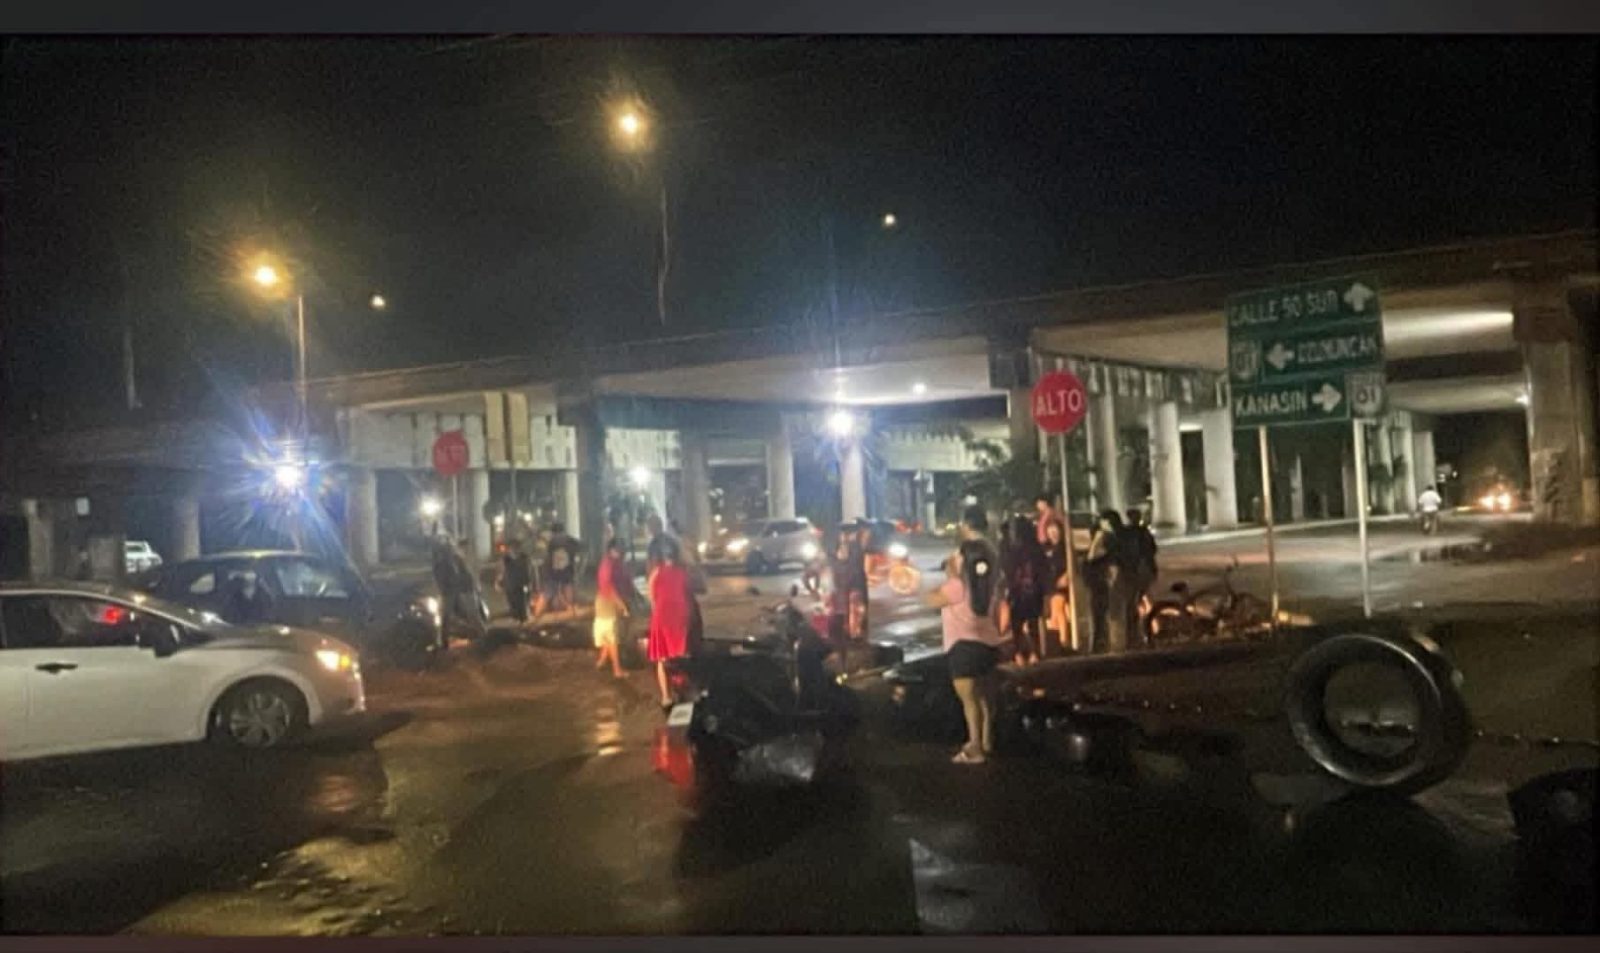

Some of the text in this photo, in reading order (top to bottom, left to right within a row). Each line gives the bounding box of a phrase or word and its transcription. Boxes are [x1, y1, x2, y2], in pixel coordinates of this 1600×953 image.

[1231, 300, 1279, 326] CALLE
[1036, 389, 1083, 416] ALTO
[1235, 390, 1307, 418] KANASIN
